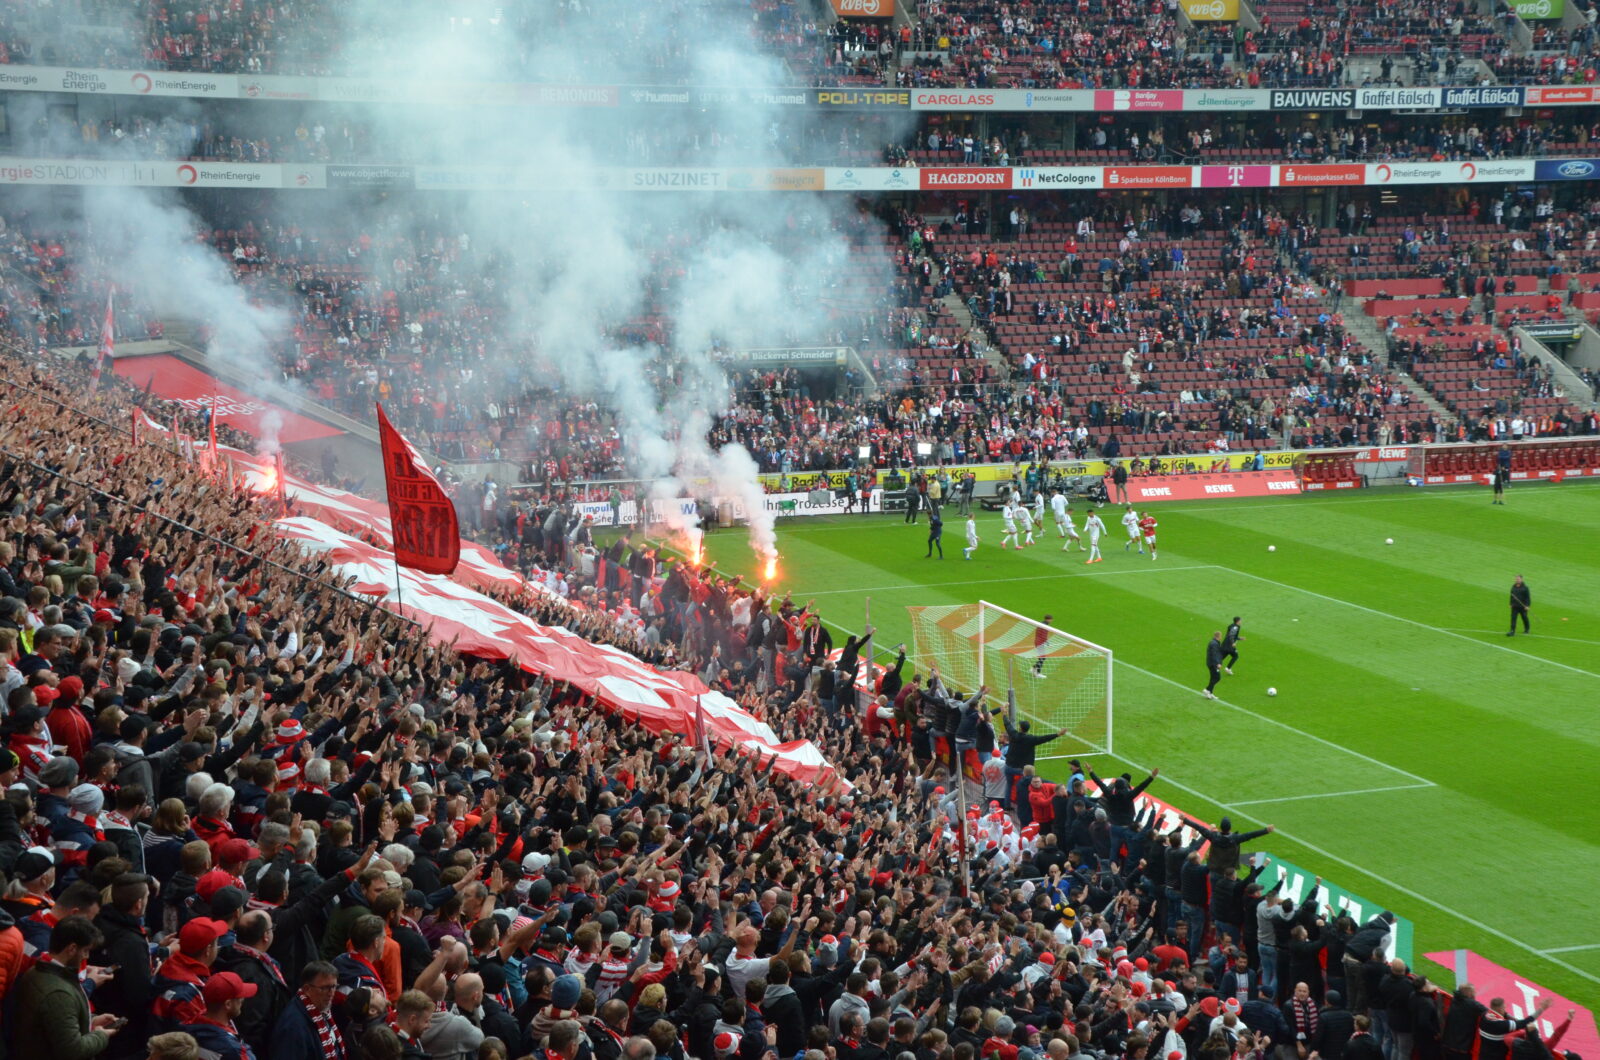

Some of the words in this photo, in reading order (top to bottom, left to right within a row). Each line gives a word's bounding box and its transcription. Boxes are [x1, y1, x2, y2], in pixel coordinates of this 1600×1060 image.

[1189, 4, 1210, 15] KVB
[0, 73, 38, 85] Energie
[65, 70, 98, 80] Rhein
[62, 79, 107, 91] Energie
[155, 80, 217, 92] RheinEnergie
[645, 91, 689, 103] hummel
[763, 93, 806, 105] hummel
[818, 93, 909, 105] POLI-TAPE
[917, 94, 994, 105] CARGLASS
[1274, 91, 1352, 108] BAUWENS
[1362, 91, 1395, 106] Gaffel
[1446, 89, 1480, 106] Gaffel
[200, 171, 261, 182] RheinEnergie
[1228, 167, 1244, 186] T
[1393, 168, 1441, 180] RheinEnergie
[1478, 166, 1526, 177] RheinEnergie
[634, 172, 720, 186] SUNZINET
[928, 173, 1005, 184] HAGEDORN
[1038, 173, 1096, 184] NetCologne
[1121, 176, 1154, 185] Sparkasse
[1297, 173, 1344, 182] Kreissparkasse
[791, 350, 834, 360] Schneider
[1277, 453, 1295, 465] Köl
[1378, 448, 1407, 459] REWE
[1204, 484, 1235, 494] REWE
[1267, 481, 1297, 490] REWE
[1141, 487, 1172, 496] REWE
[583, 503, 613, 514] impul
[763, 500, 783, 510] Ihr
